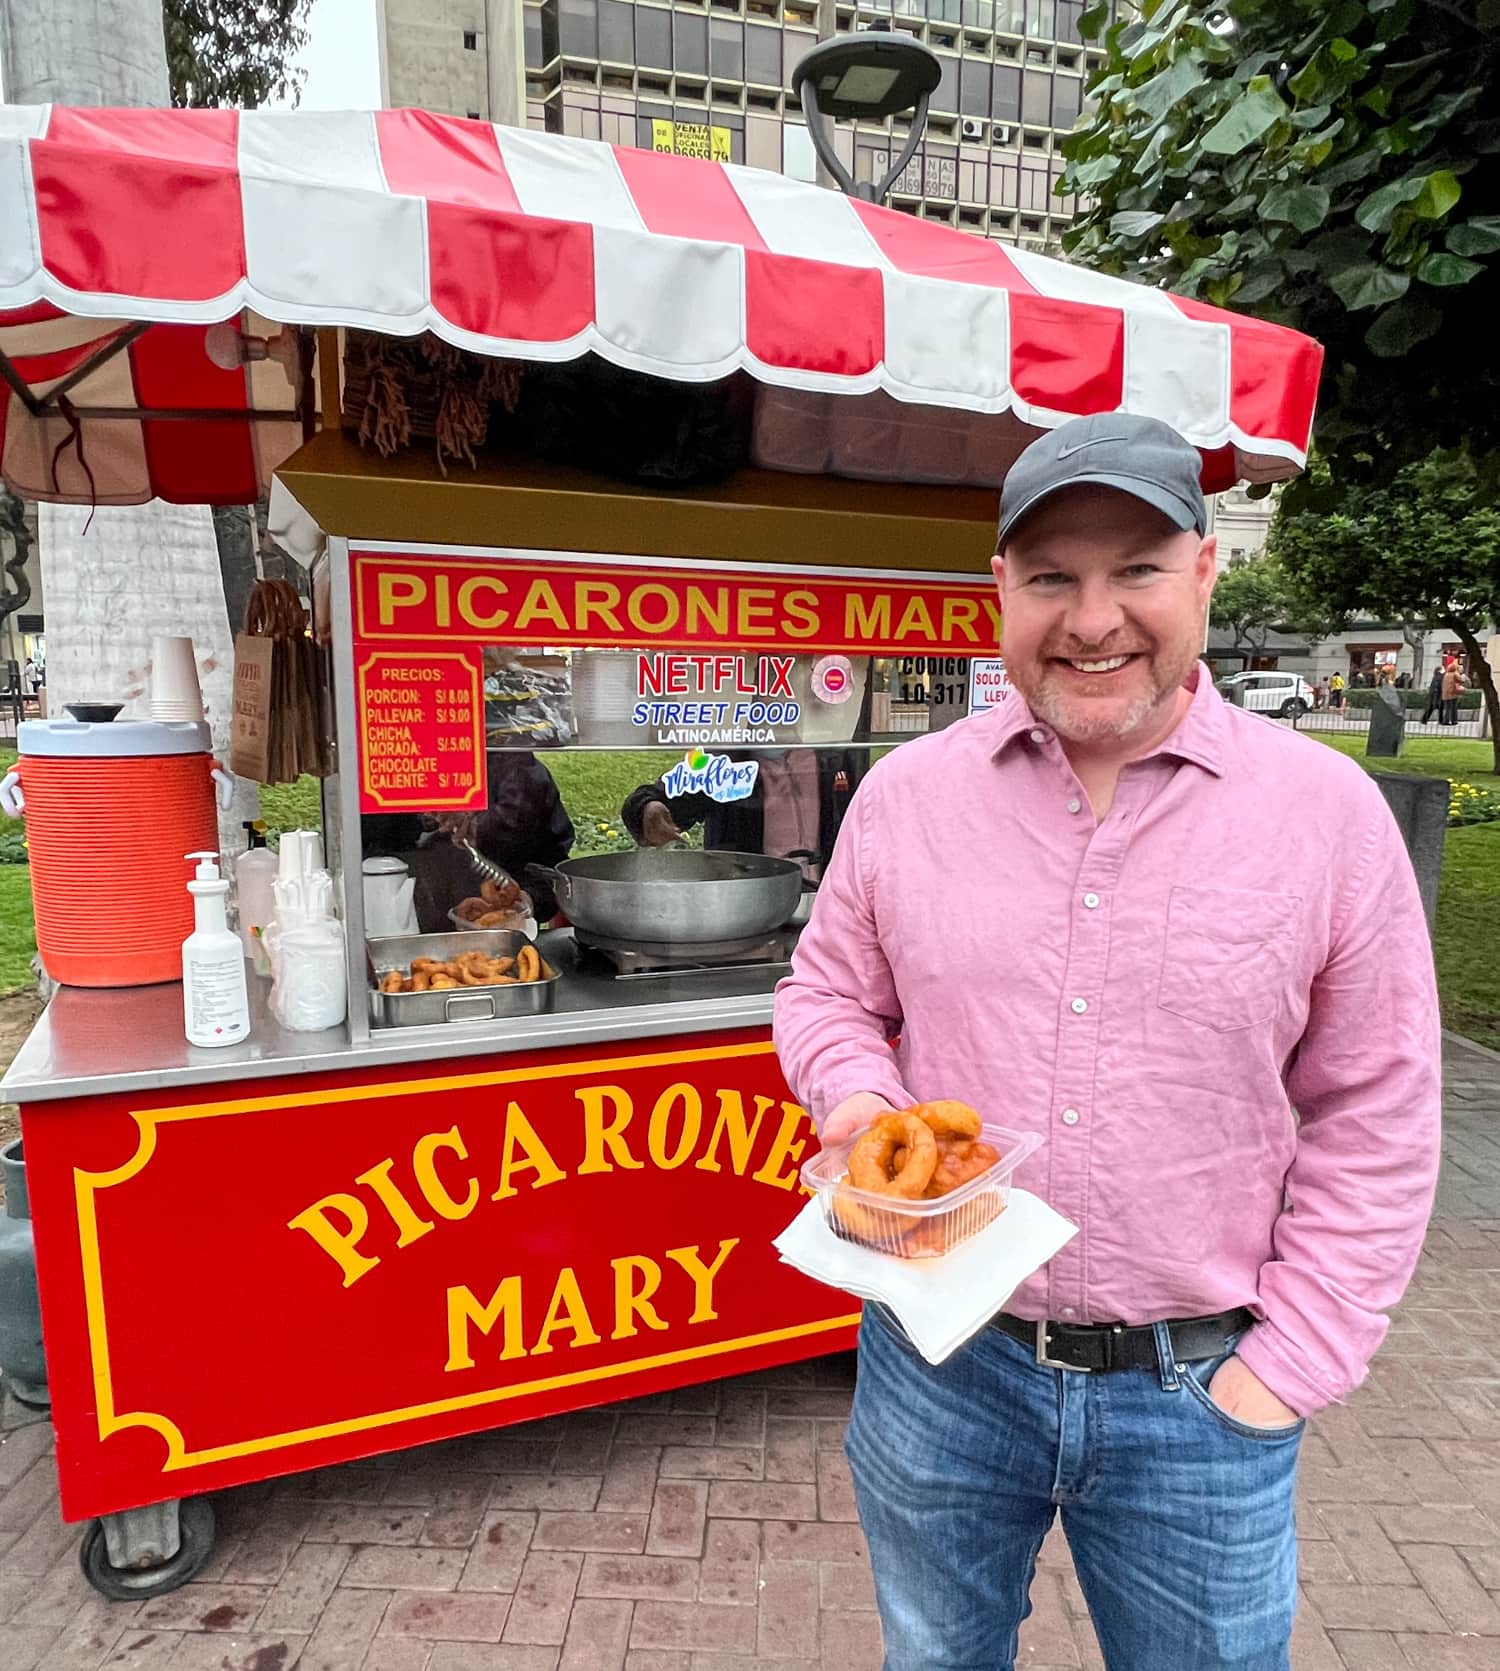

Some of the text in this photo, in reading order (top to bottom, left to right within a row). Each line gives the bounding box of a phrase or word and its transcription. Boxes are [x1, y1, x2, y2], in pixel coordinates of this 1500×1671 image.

[674, 123, 710, 135] VENTA
[377, 572, 1003, 642] PICARONES MARY
[381, 668, 445, 682] PRECIOS:
[637, 653, 796, 698] NETFLIX
[976, 673, 1000, 685] SOLO
[902, 683, 966, 705] 10-317
[632, 702, 800, 725] STREET FOOD
[368, 726, 411, 741] CHICHA
[657, 726, 776, 744] LATINOAMÉRICA
[369, 741, 421, 756] MORADA:
[370, 757, 437, 772] CHOCOLATE
[370, 773, 428, 789] CALIENTE:
[664, 756, 754, 796] Miraflores
[286, 1082, 816, 1288] PICARONE
[444, 1236, 740, 1372] MARY
